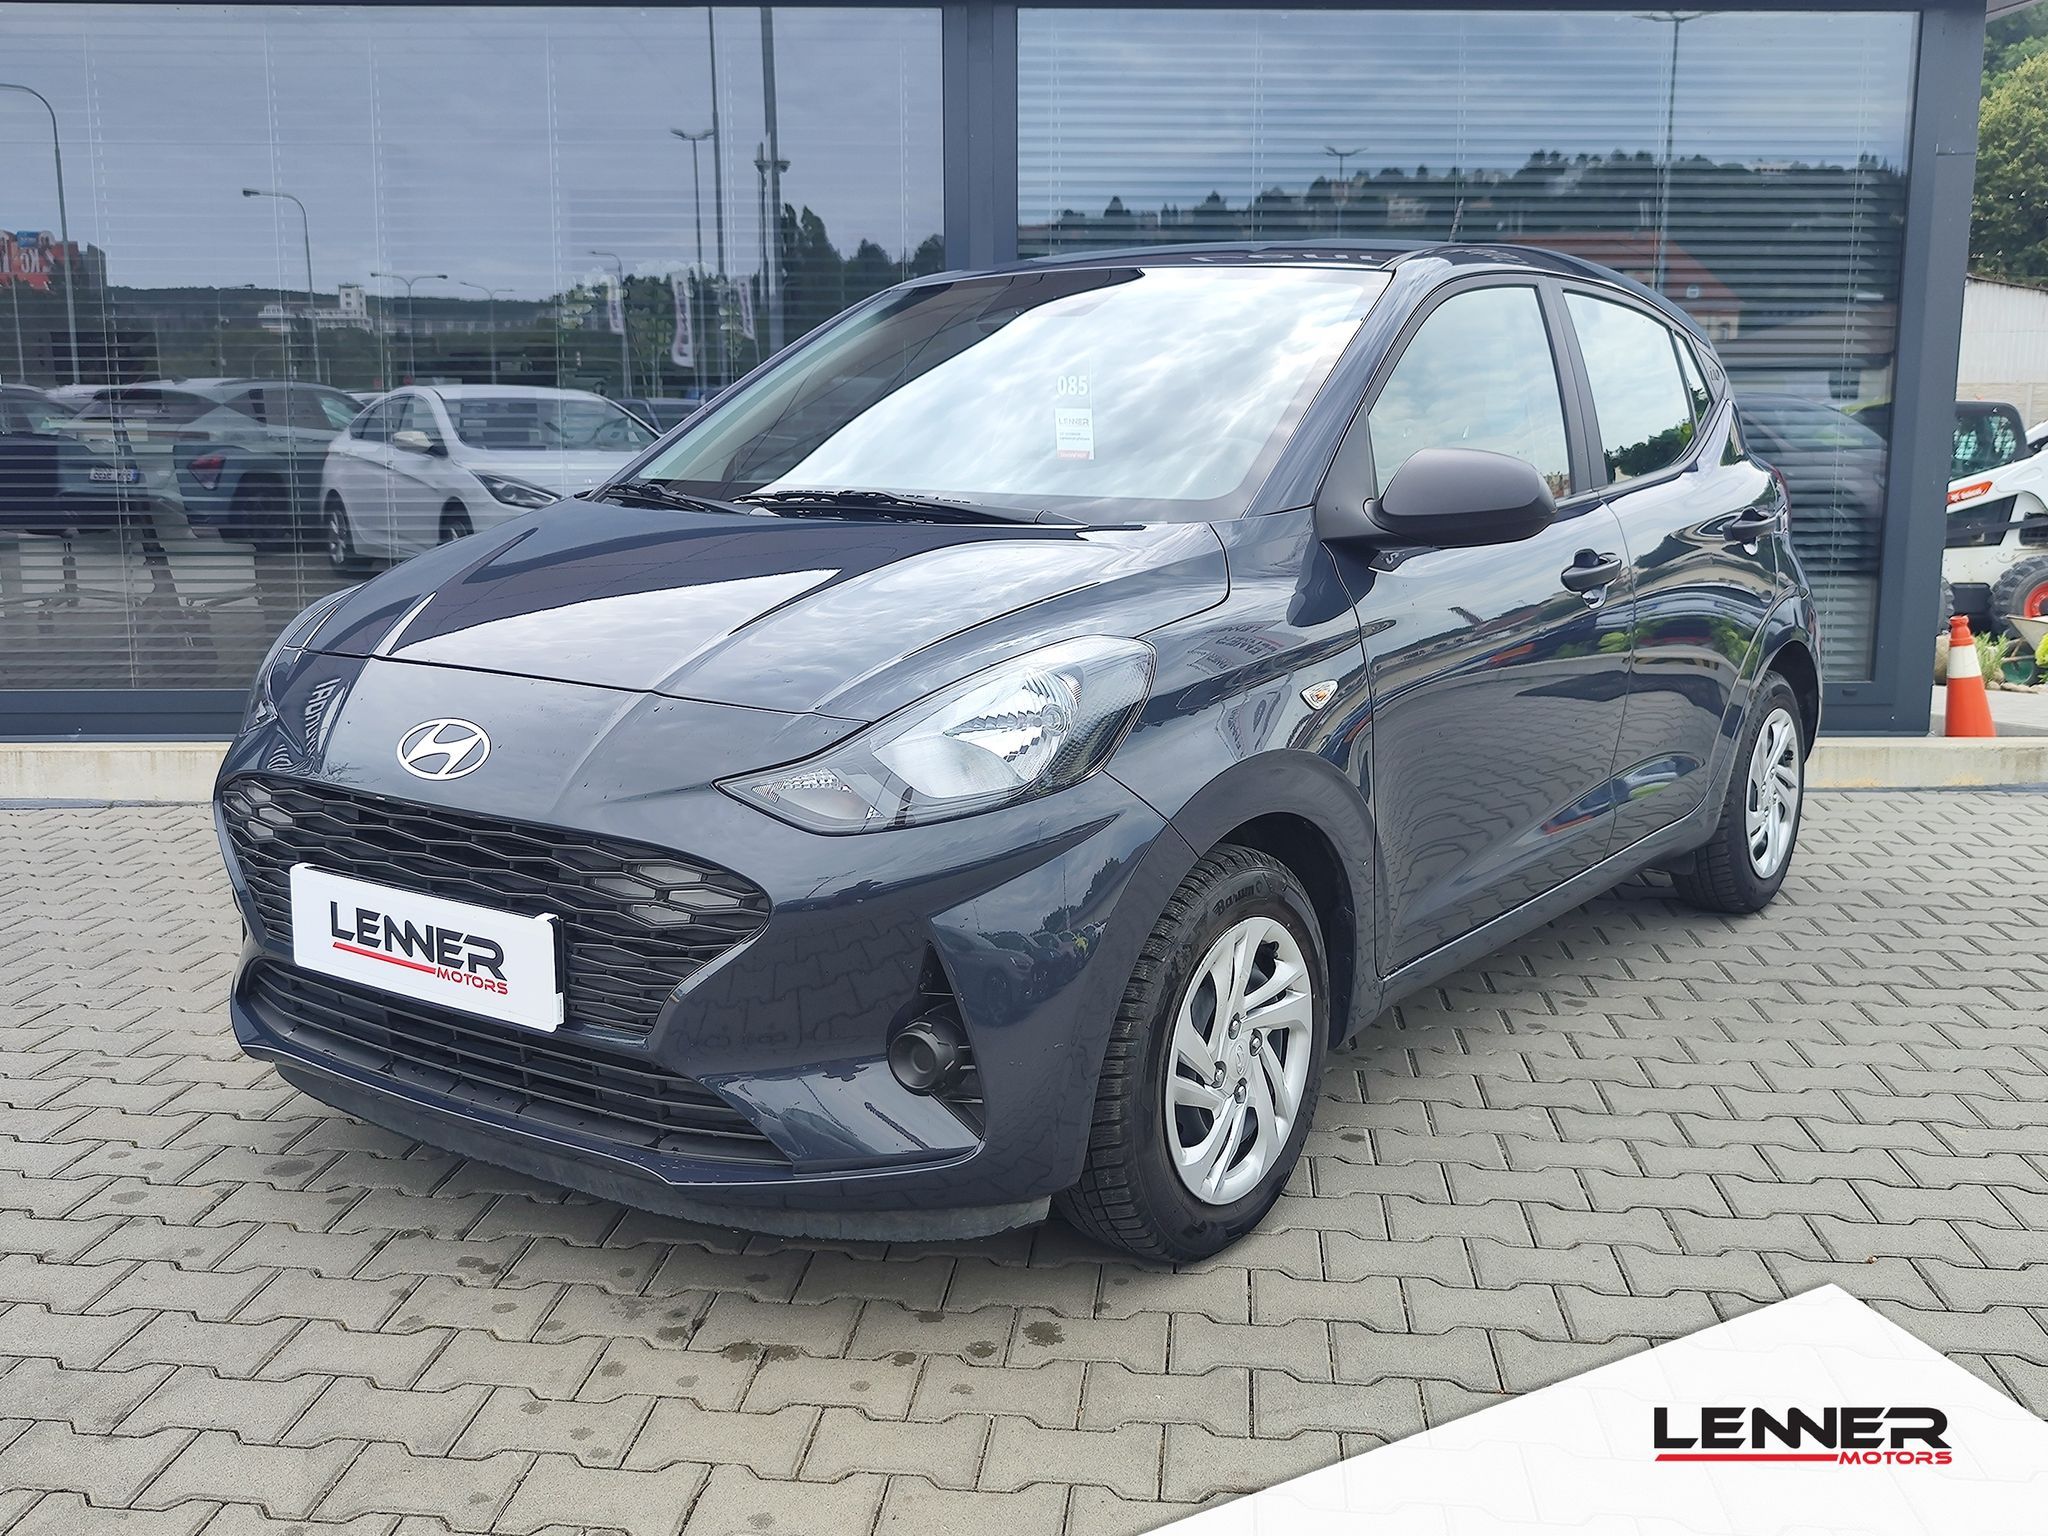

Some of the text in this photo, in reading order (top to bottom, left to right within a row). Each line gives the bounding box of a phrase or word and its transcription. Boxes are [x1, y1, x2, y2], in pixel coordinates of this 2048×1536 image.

[1057, 375, 1088, 396] 085
[1213, 884, 1255, 916] Barum
[330, 900, 508, 982] LENNER
[436, 966, 508, 995] MOTORS
